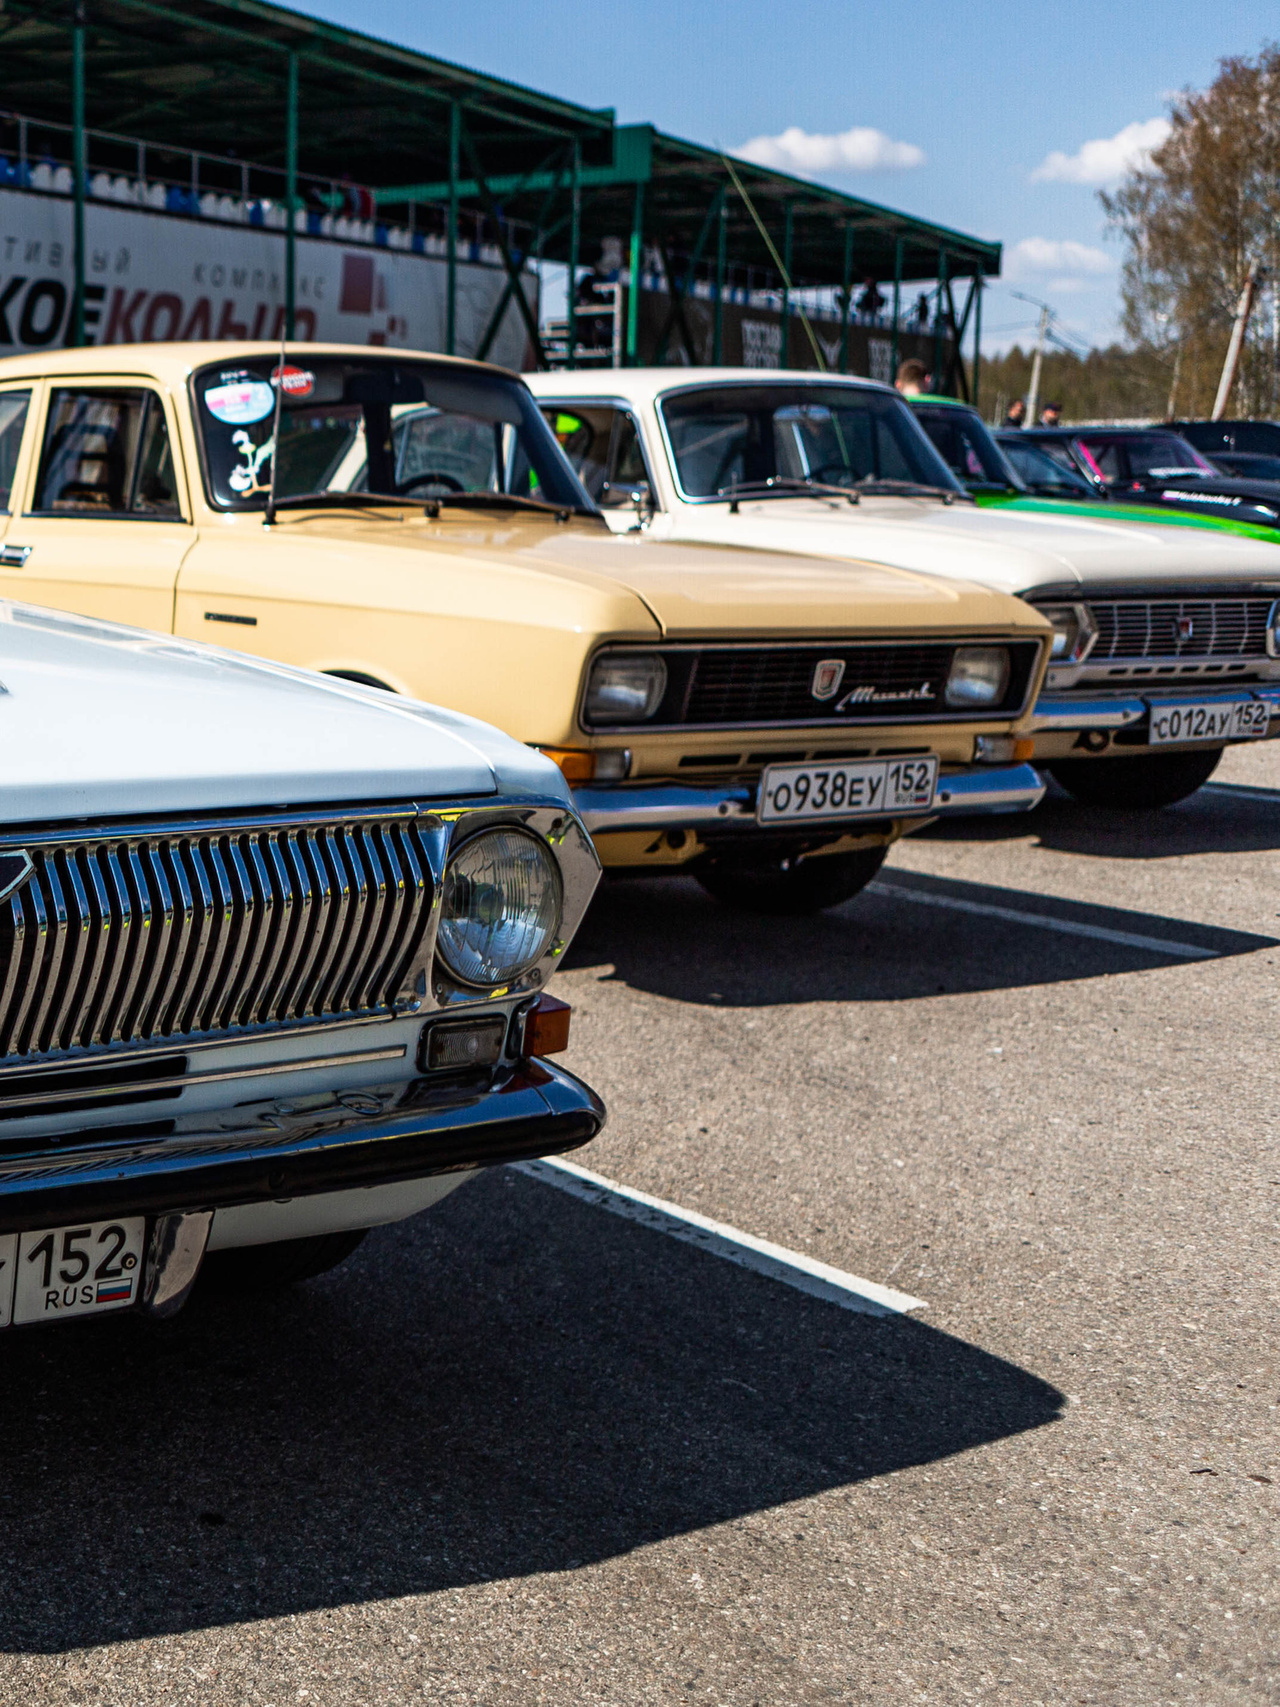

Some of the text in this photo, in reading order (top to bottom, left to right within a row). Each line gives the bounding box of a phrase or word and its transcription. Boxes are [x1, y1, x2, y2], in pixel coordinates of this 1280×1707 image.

[1234, 703, 1266, 724] 152
[889, 763, 929, 792] 152
[27, 1225, 127, 1287] 152
[45, 1285, 94, 1311] RUS
